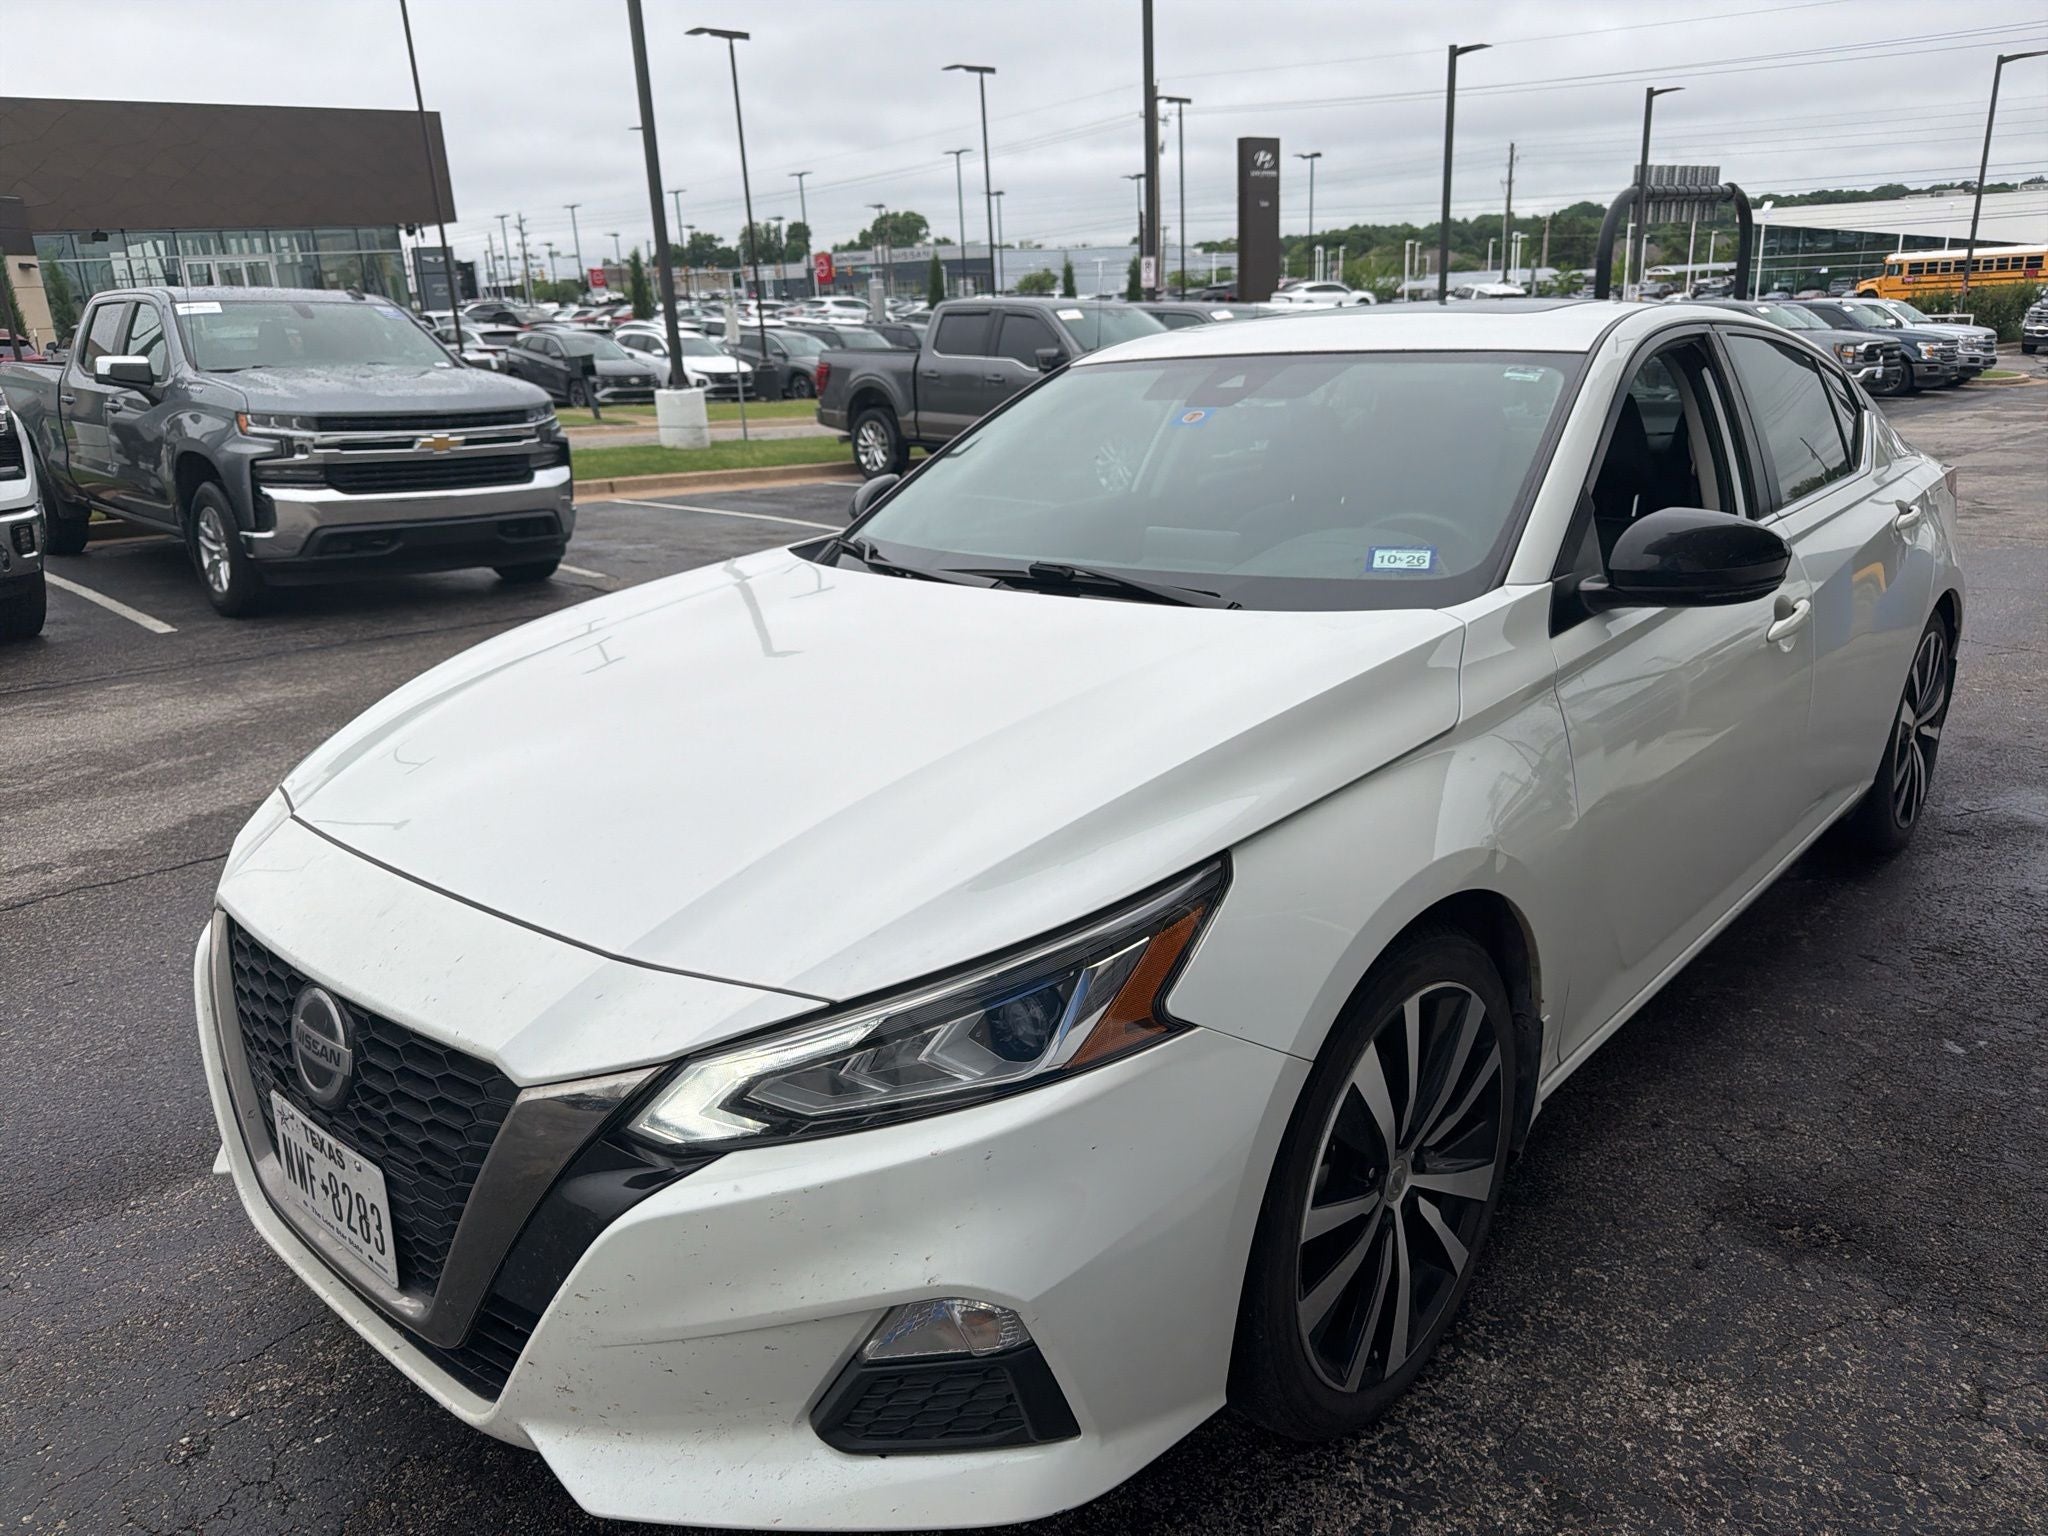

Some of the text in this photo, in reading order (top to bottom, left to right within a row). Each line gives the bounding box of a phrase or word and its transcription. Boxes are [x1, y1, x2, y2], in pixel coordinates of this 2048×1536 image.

[296, 1024, 341, 1067] NISSAN
[301, 1120, 346, 1171] TEXAS
[311, 1204, 363, 1254] The Lone Star State
